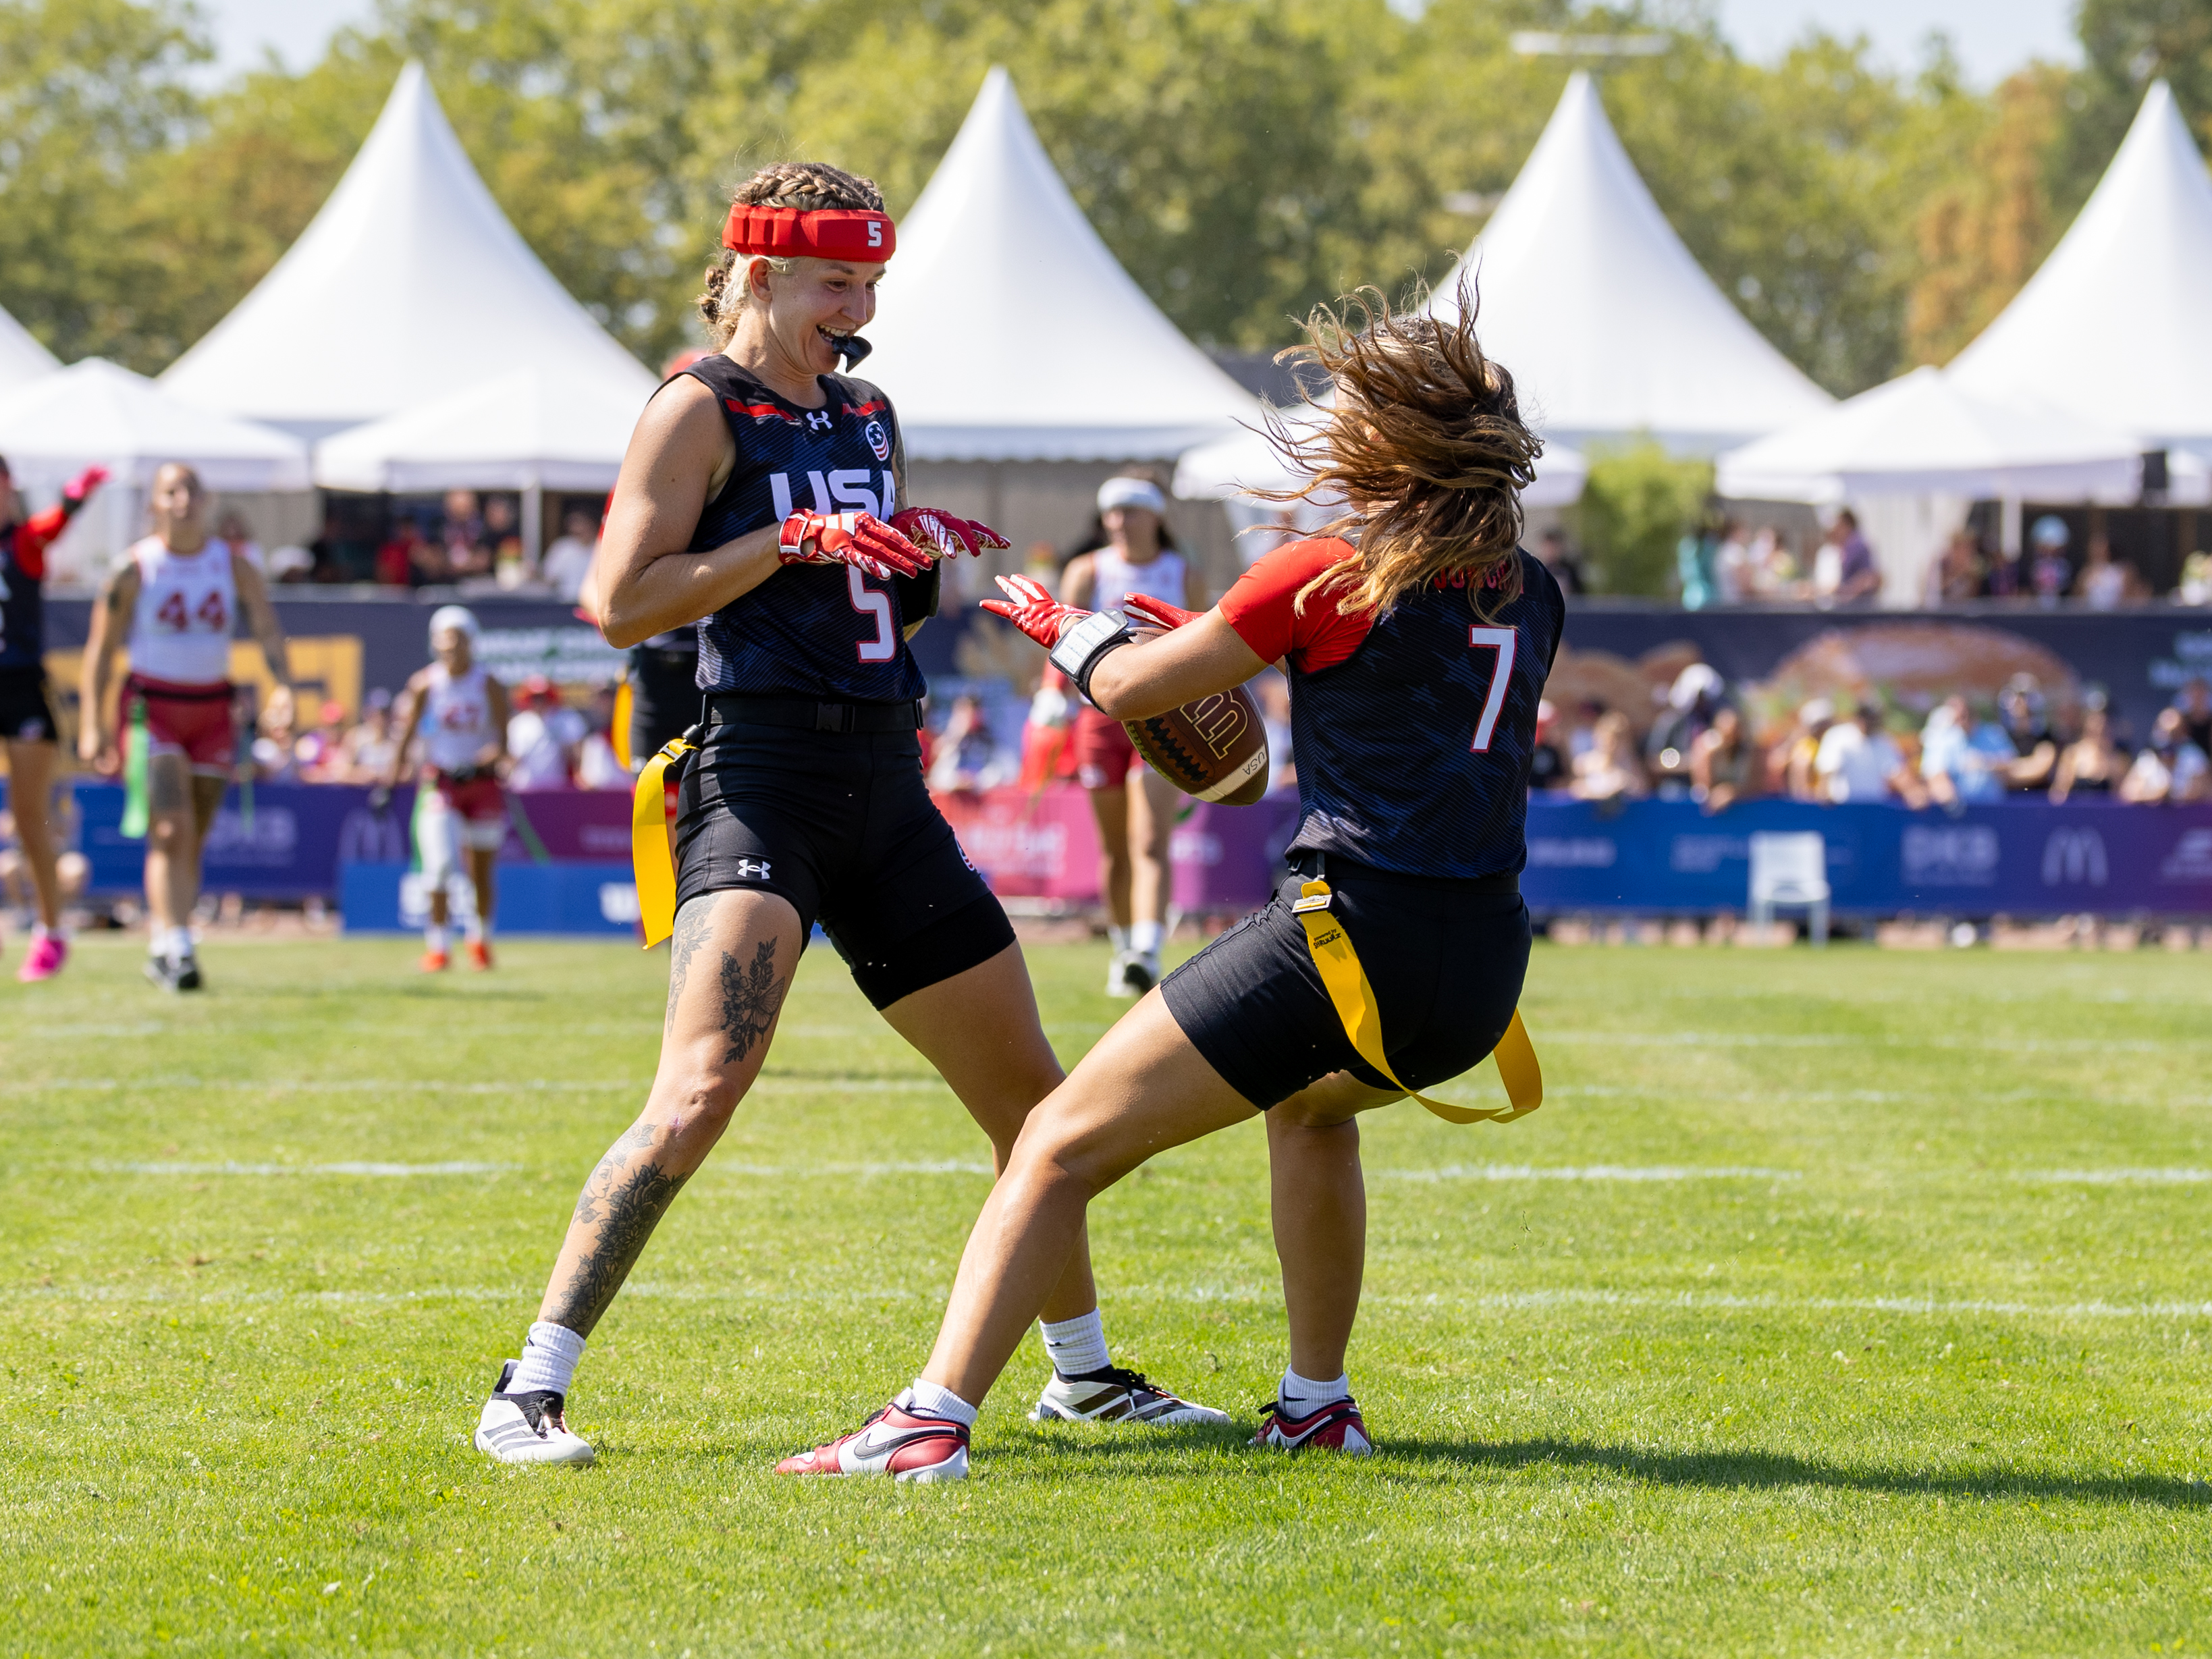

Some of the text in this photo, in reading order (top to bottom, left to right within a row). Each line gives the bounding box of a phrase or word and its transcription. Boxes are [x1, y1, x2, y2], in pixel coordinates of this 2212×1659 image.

[867, 220, 882, 248] 5
[157, 589, 226, 632] 44
[846, 564, 896, 663] 5
[1469, 624, 1517, 753] 7
[1242, 751, 1266, 776] USA
